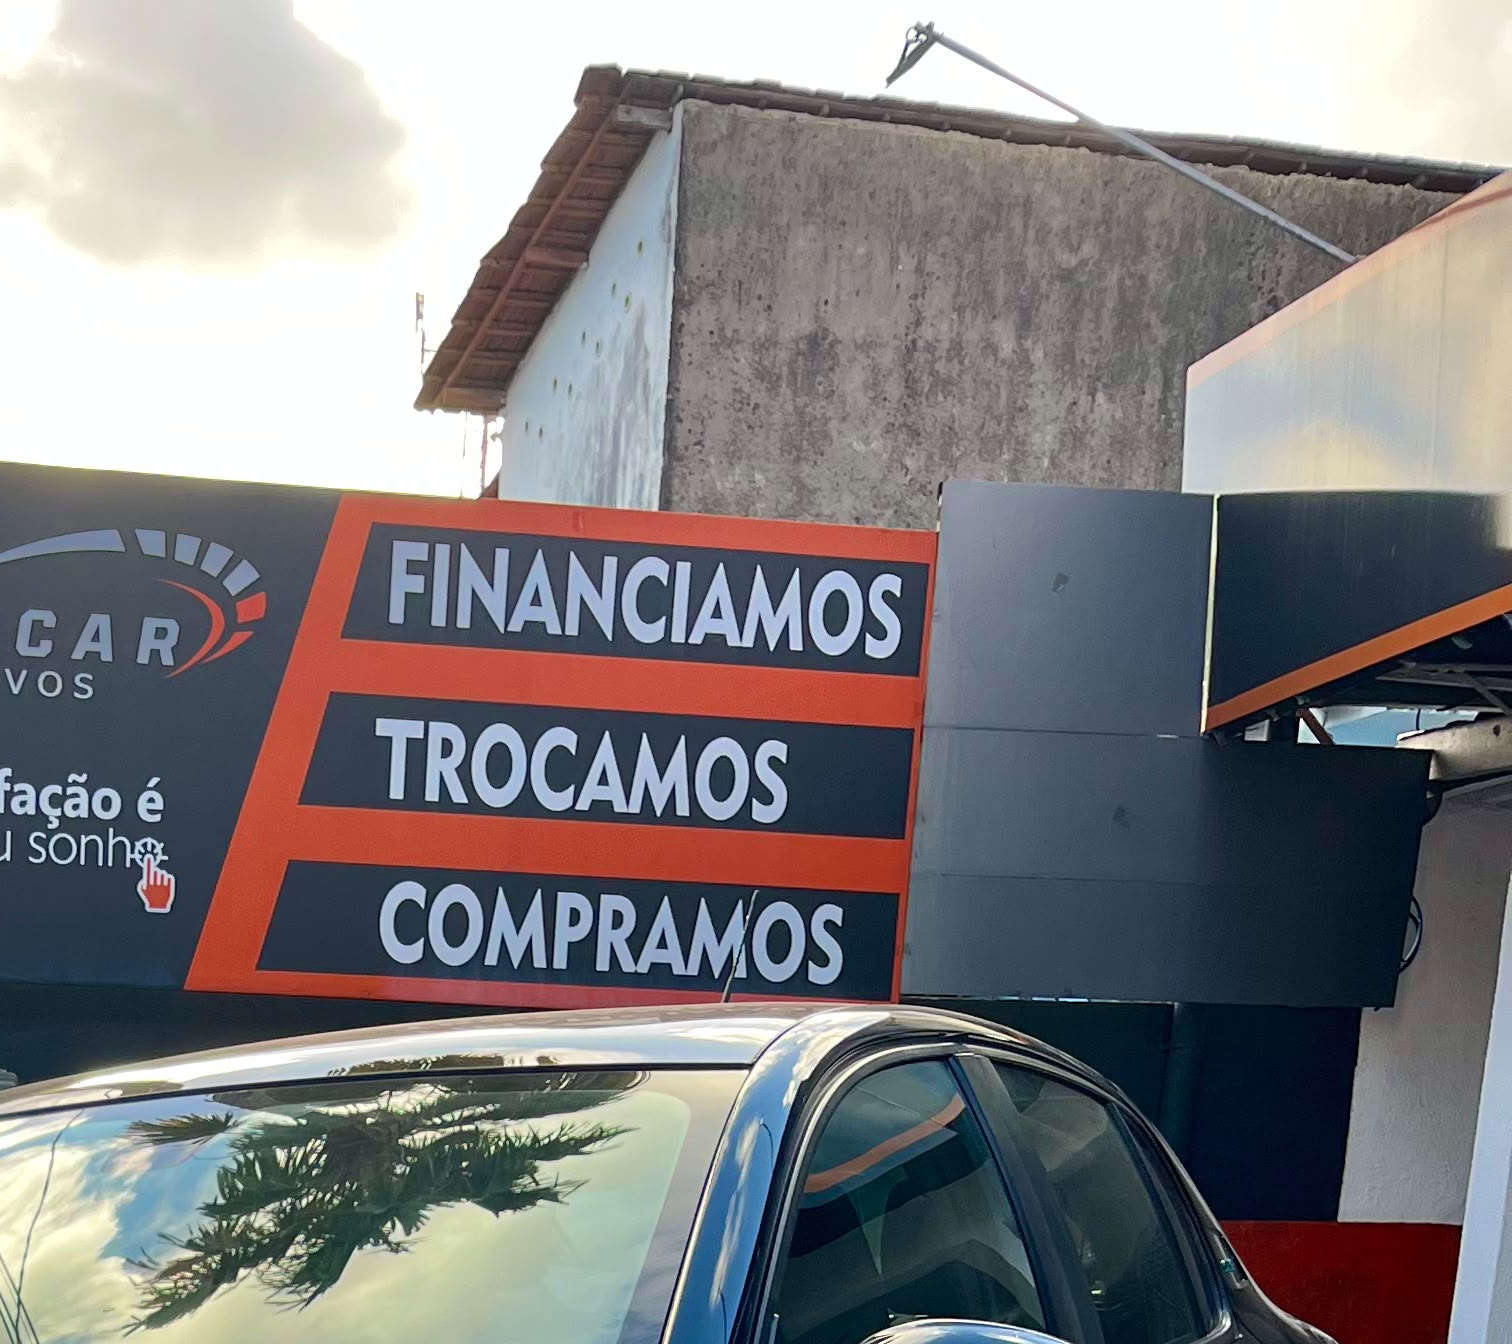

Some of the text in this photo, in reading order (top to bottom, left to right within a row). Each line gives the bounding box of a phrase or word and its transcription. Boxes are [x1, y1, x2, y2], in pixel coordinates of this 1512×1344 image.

[388, 539, 903, 660] FINANCIAMOS
[135, 777, 165, 823] é
[375, 717, 789, 824] TROCAMOS
[379, 880, 844, 986] COMPRAMOS
